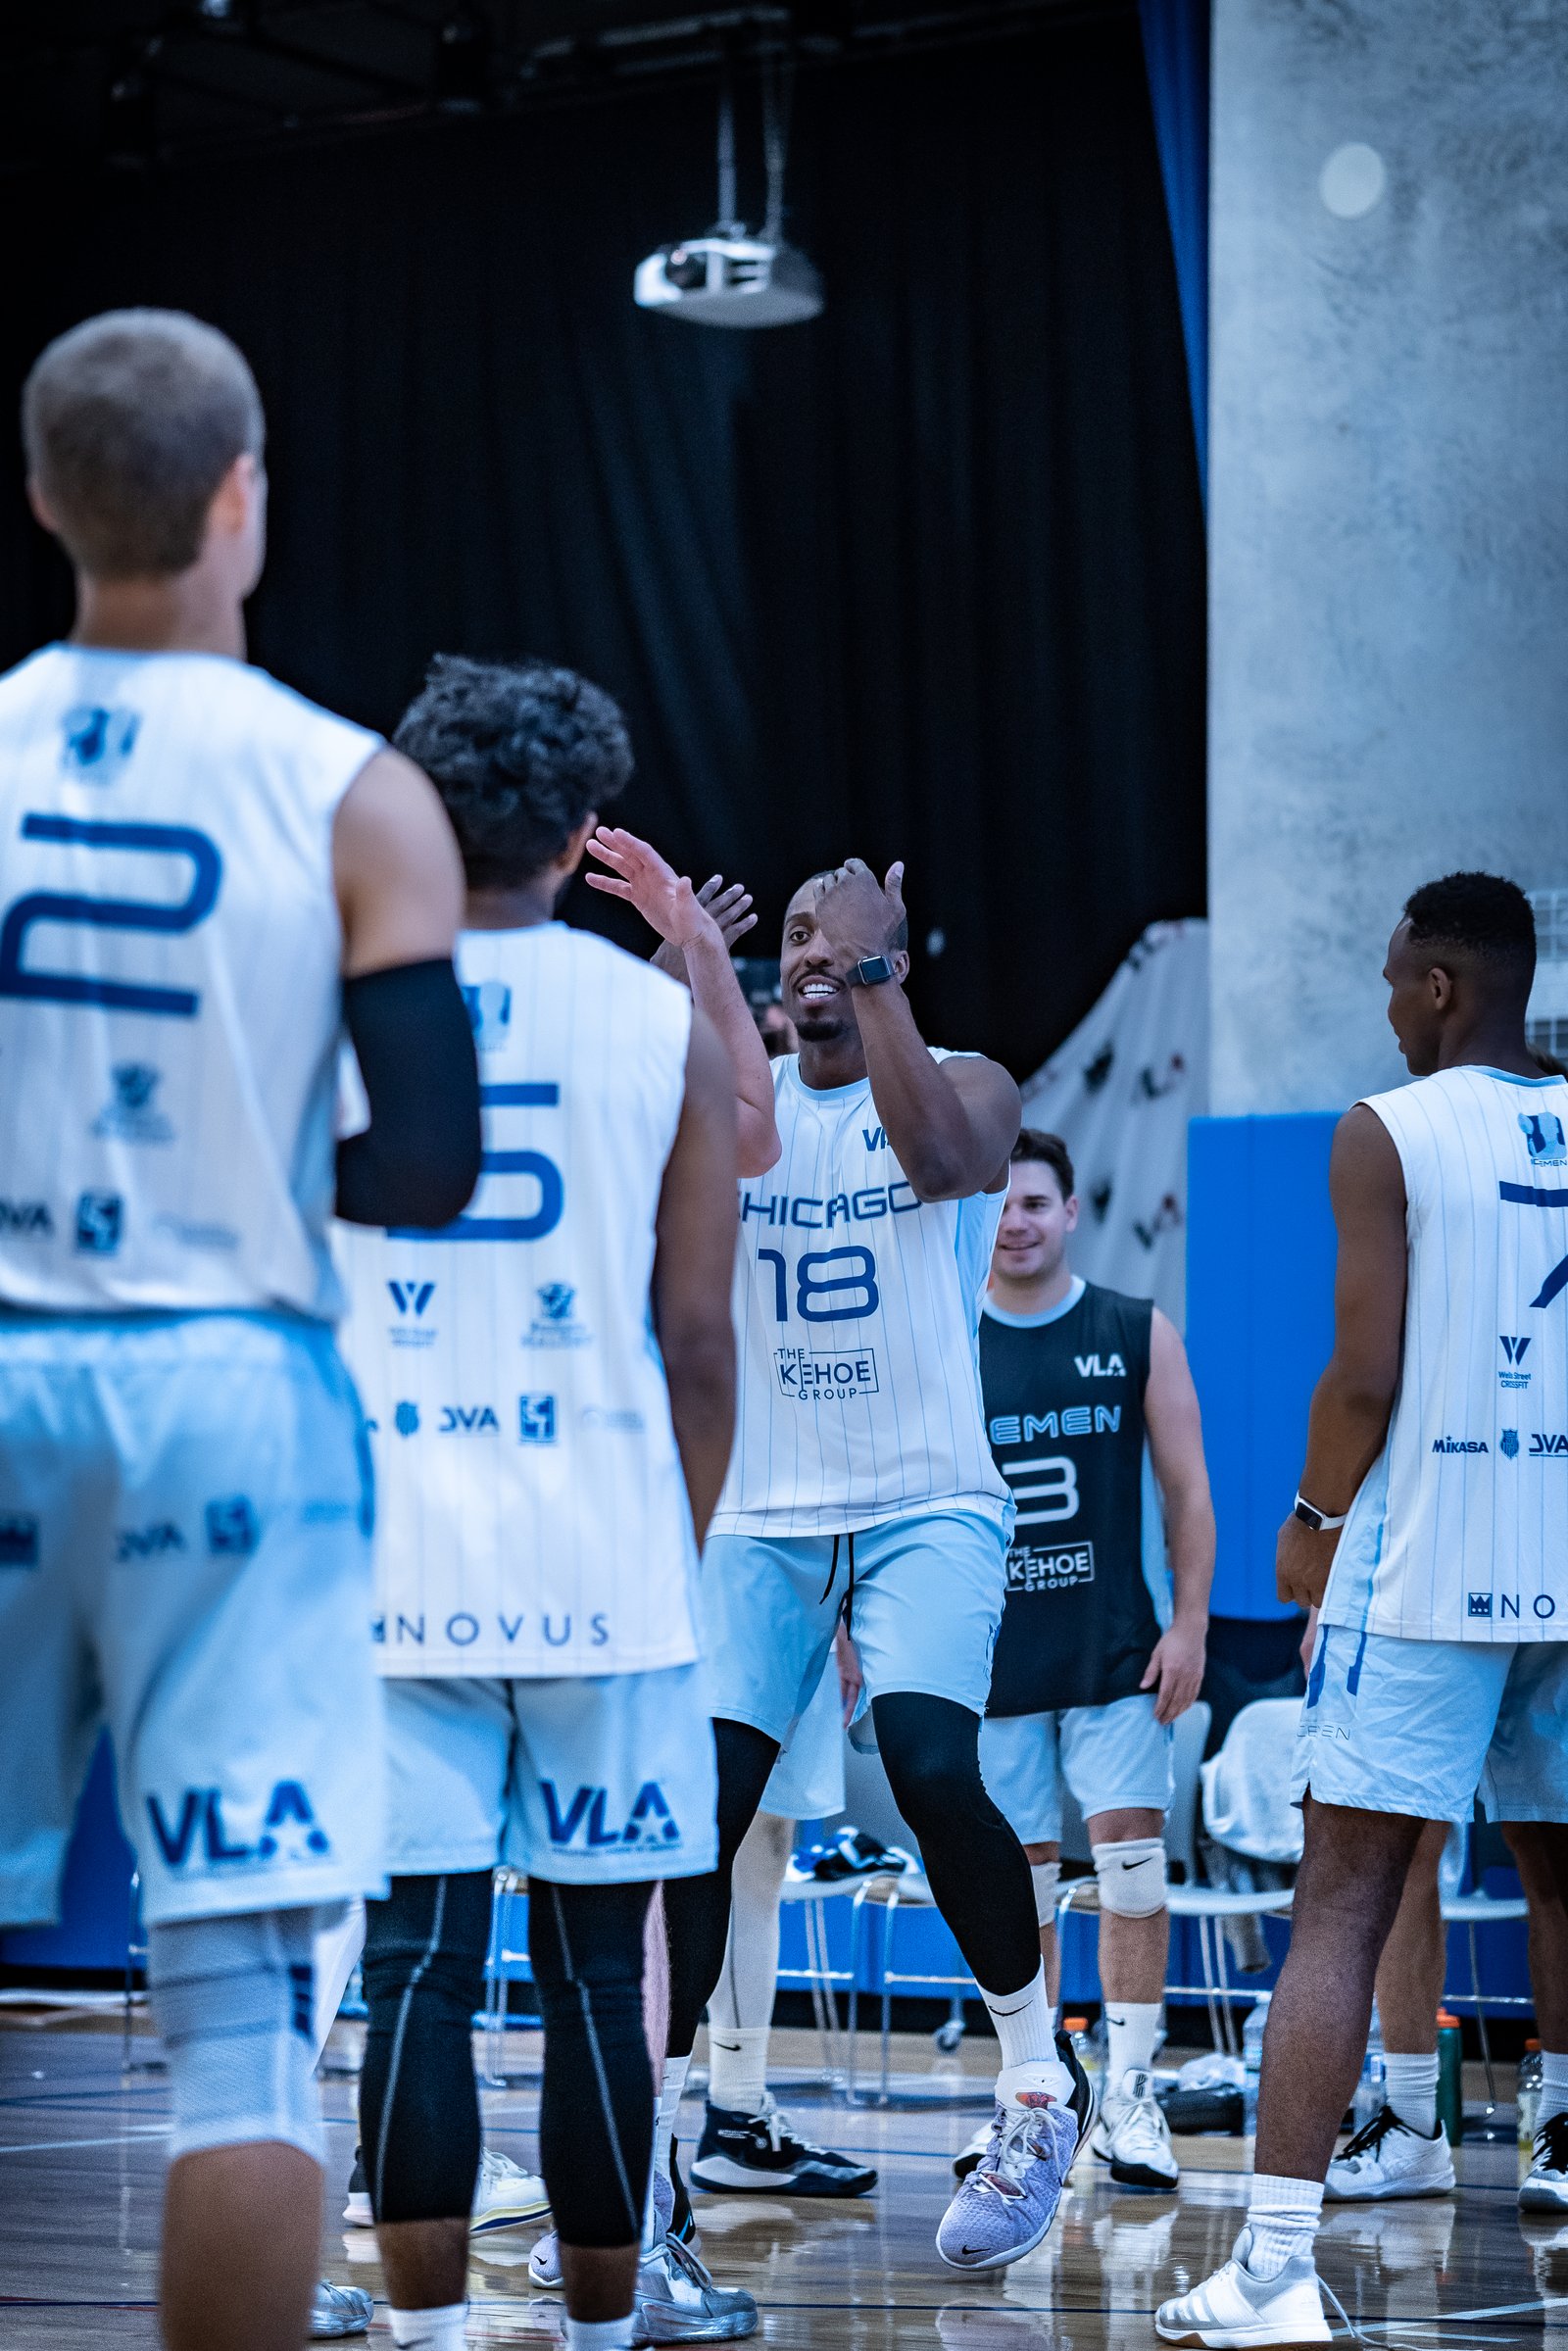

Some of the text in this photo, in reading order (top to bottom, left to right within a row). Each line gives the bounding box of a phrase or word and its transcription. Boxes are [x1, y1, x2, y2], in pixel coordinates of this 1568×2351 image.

[738, 1181, 922, 1229] HICAGO
[758, 1245, 880, 1323] 18
[777, 1347, 806, 1359] THE
[1074, 1353, 1127, 1378] VLA
[780, 1360, 871, 1385] KEHOE
[798, 1388, 858, 1400] GROUP
[990, 1404, 1122, 1445] EMEN
[1002, 1456, 1079, 1526] 3
[1008, 1551, 1090, 1581] KEHOE
[1024, 1576, 1079, 1592] GROUP
[395, 1612, 609, 1646] NOVUS
[146, 1781, 329, 1865] VLA
[539, 1782, 679, 1846] VLA
